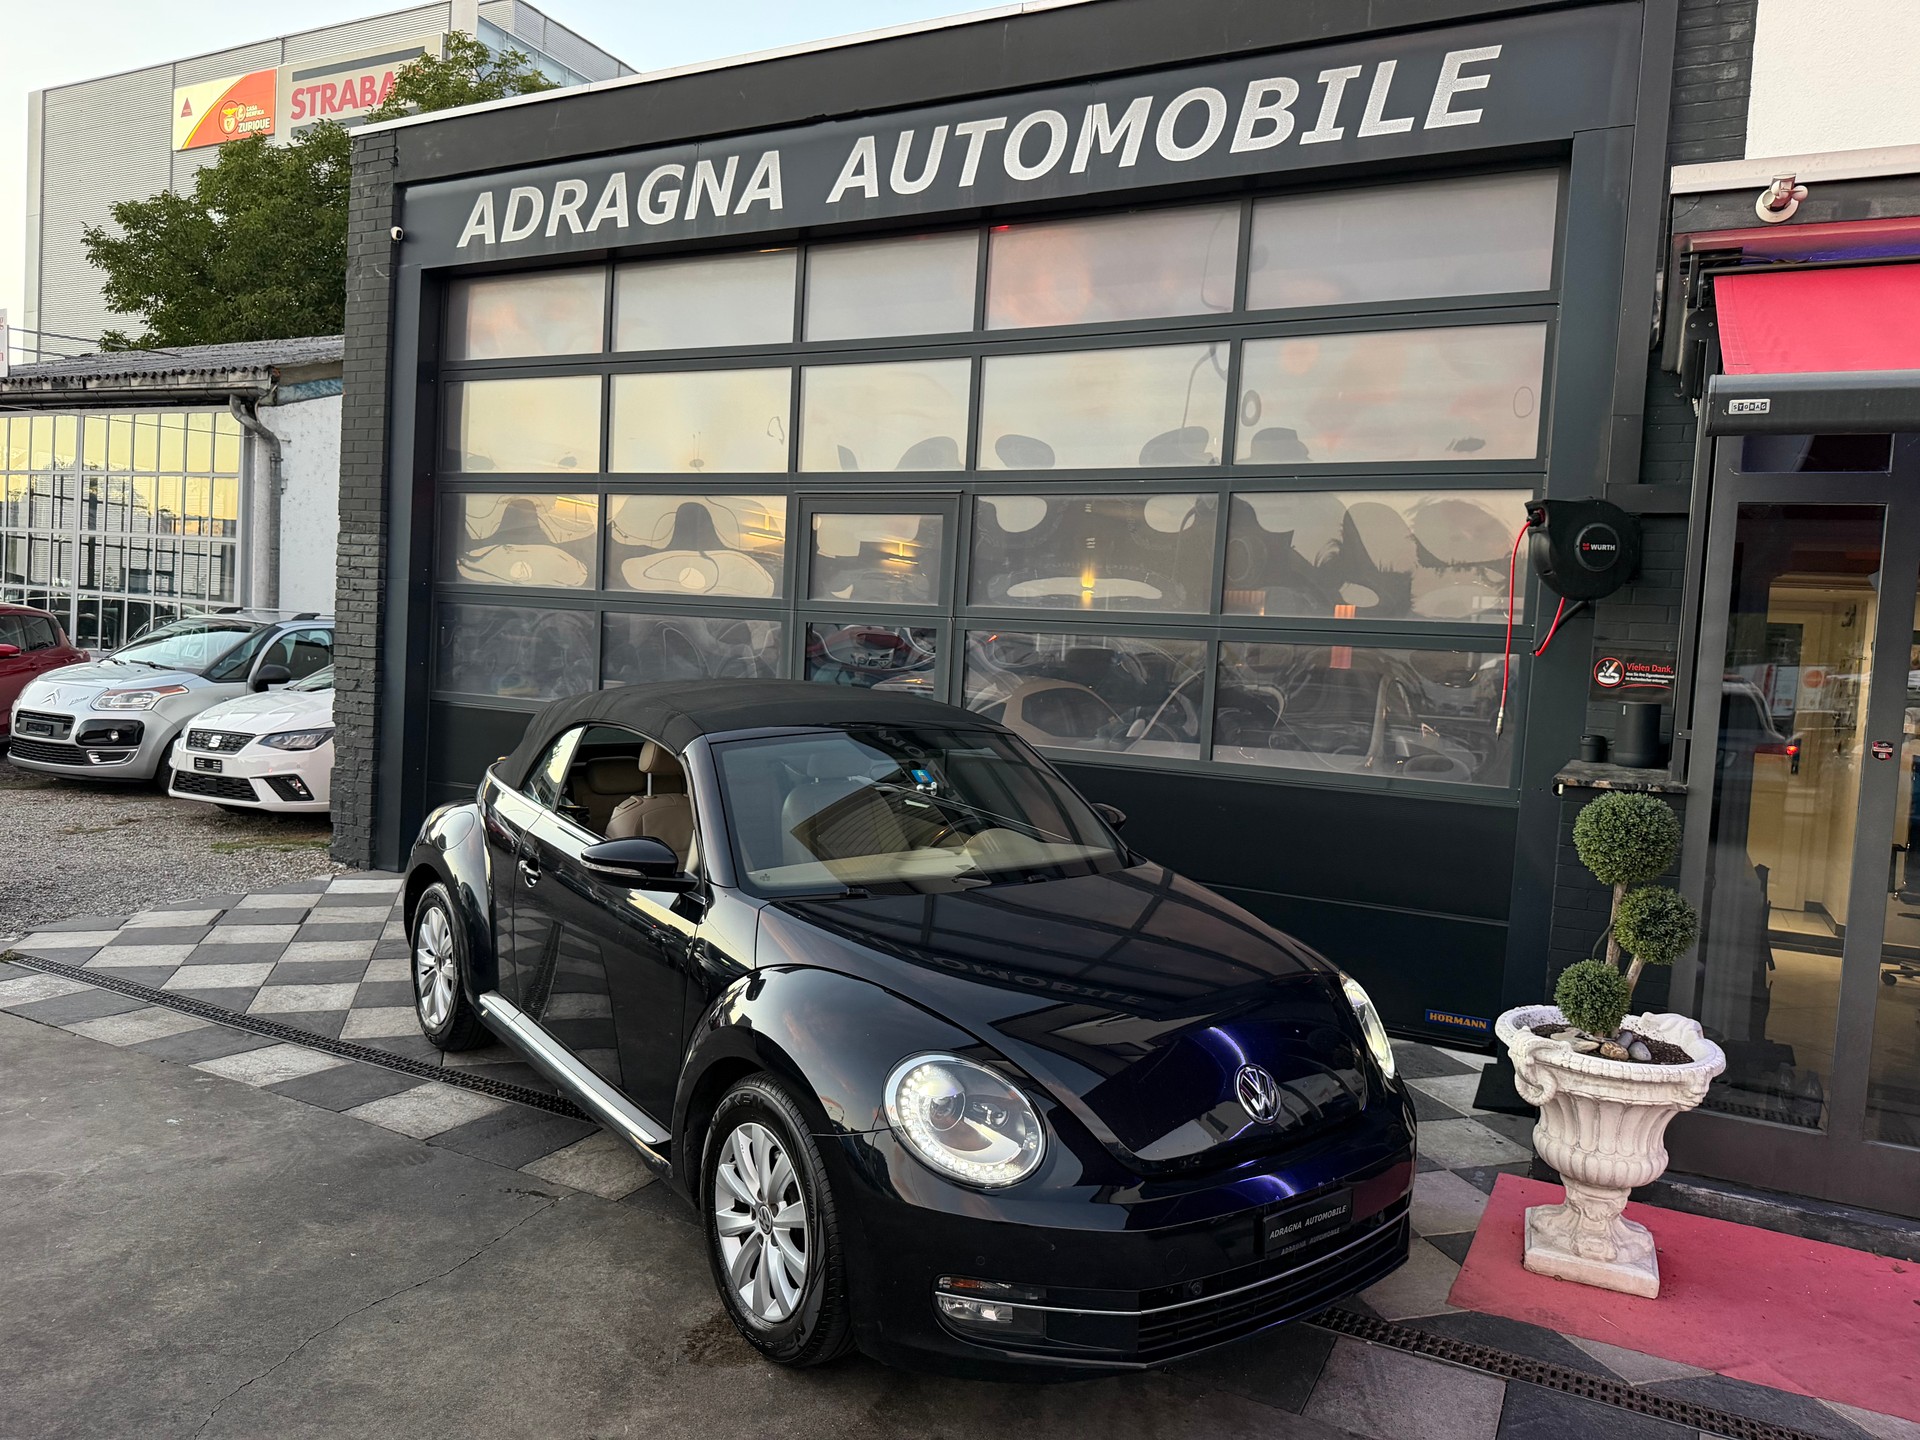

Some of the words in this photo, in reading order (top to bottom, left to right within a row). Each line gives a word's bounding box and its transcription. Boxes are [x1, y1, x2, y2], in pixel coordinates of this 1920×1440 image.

[290, 71, 395, 121] STRABA
[457, 150, 785, 248] ADRAGNA
[825, 44, 1503, 204] AUTOMOBILE
[1733, 402, 1767, 411] STOBAG
[1626, 663, 1650, 672] Vielen
[1651, 664, 1674, 674] Dank,
[1269, 1221, 1302, 1240] ADRAGNA
[1304, 1205, 1347, 1227] AUTOMOBILE
